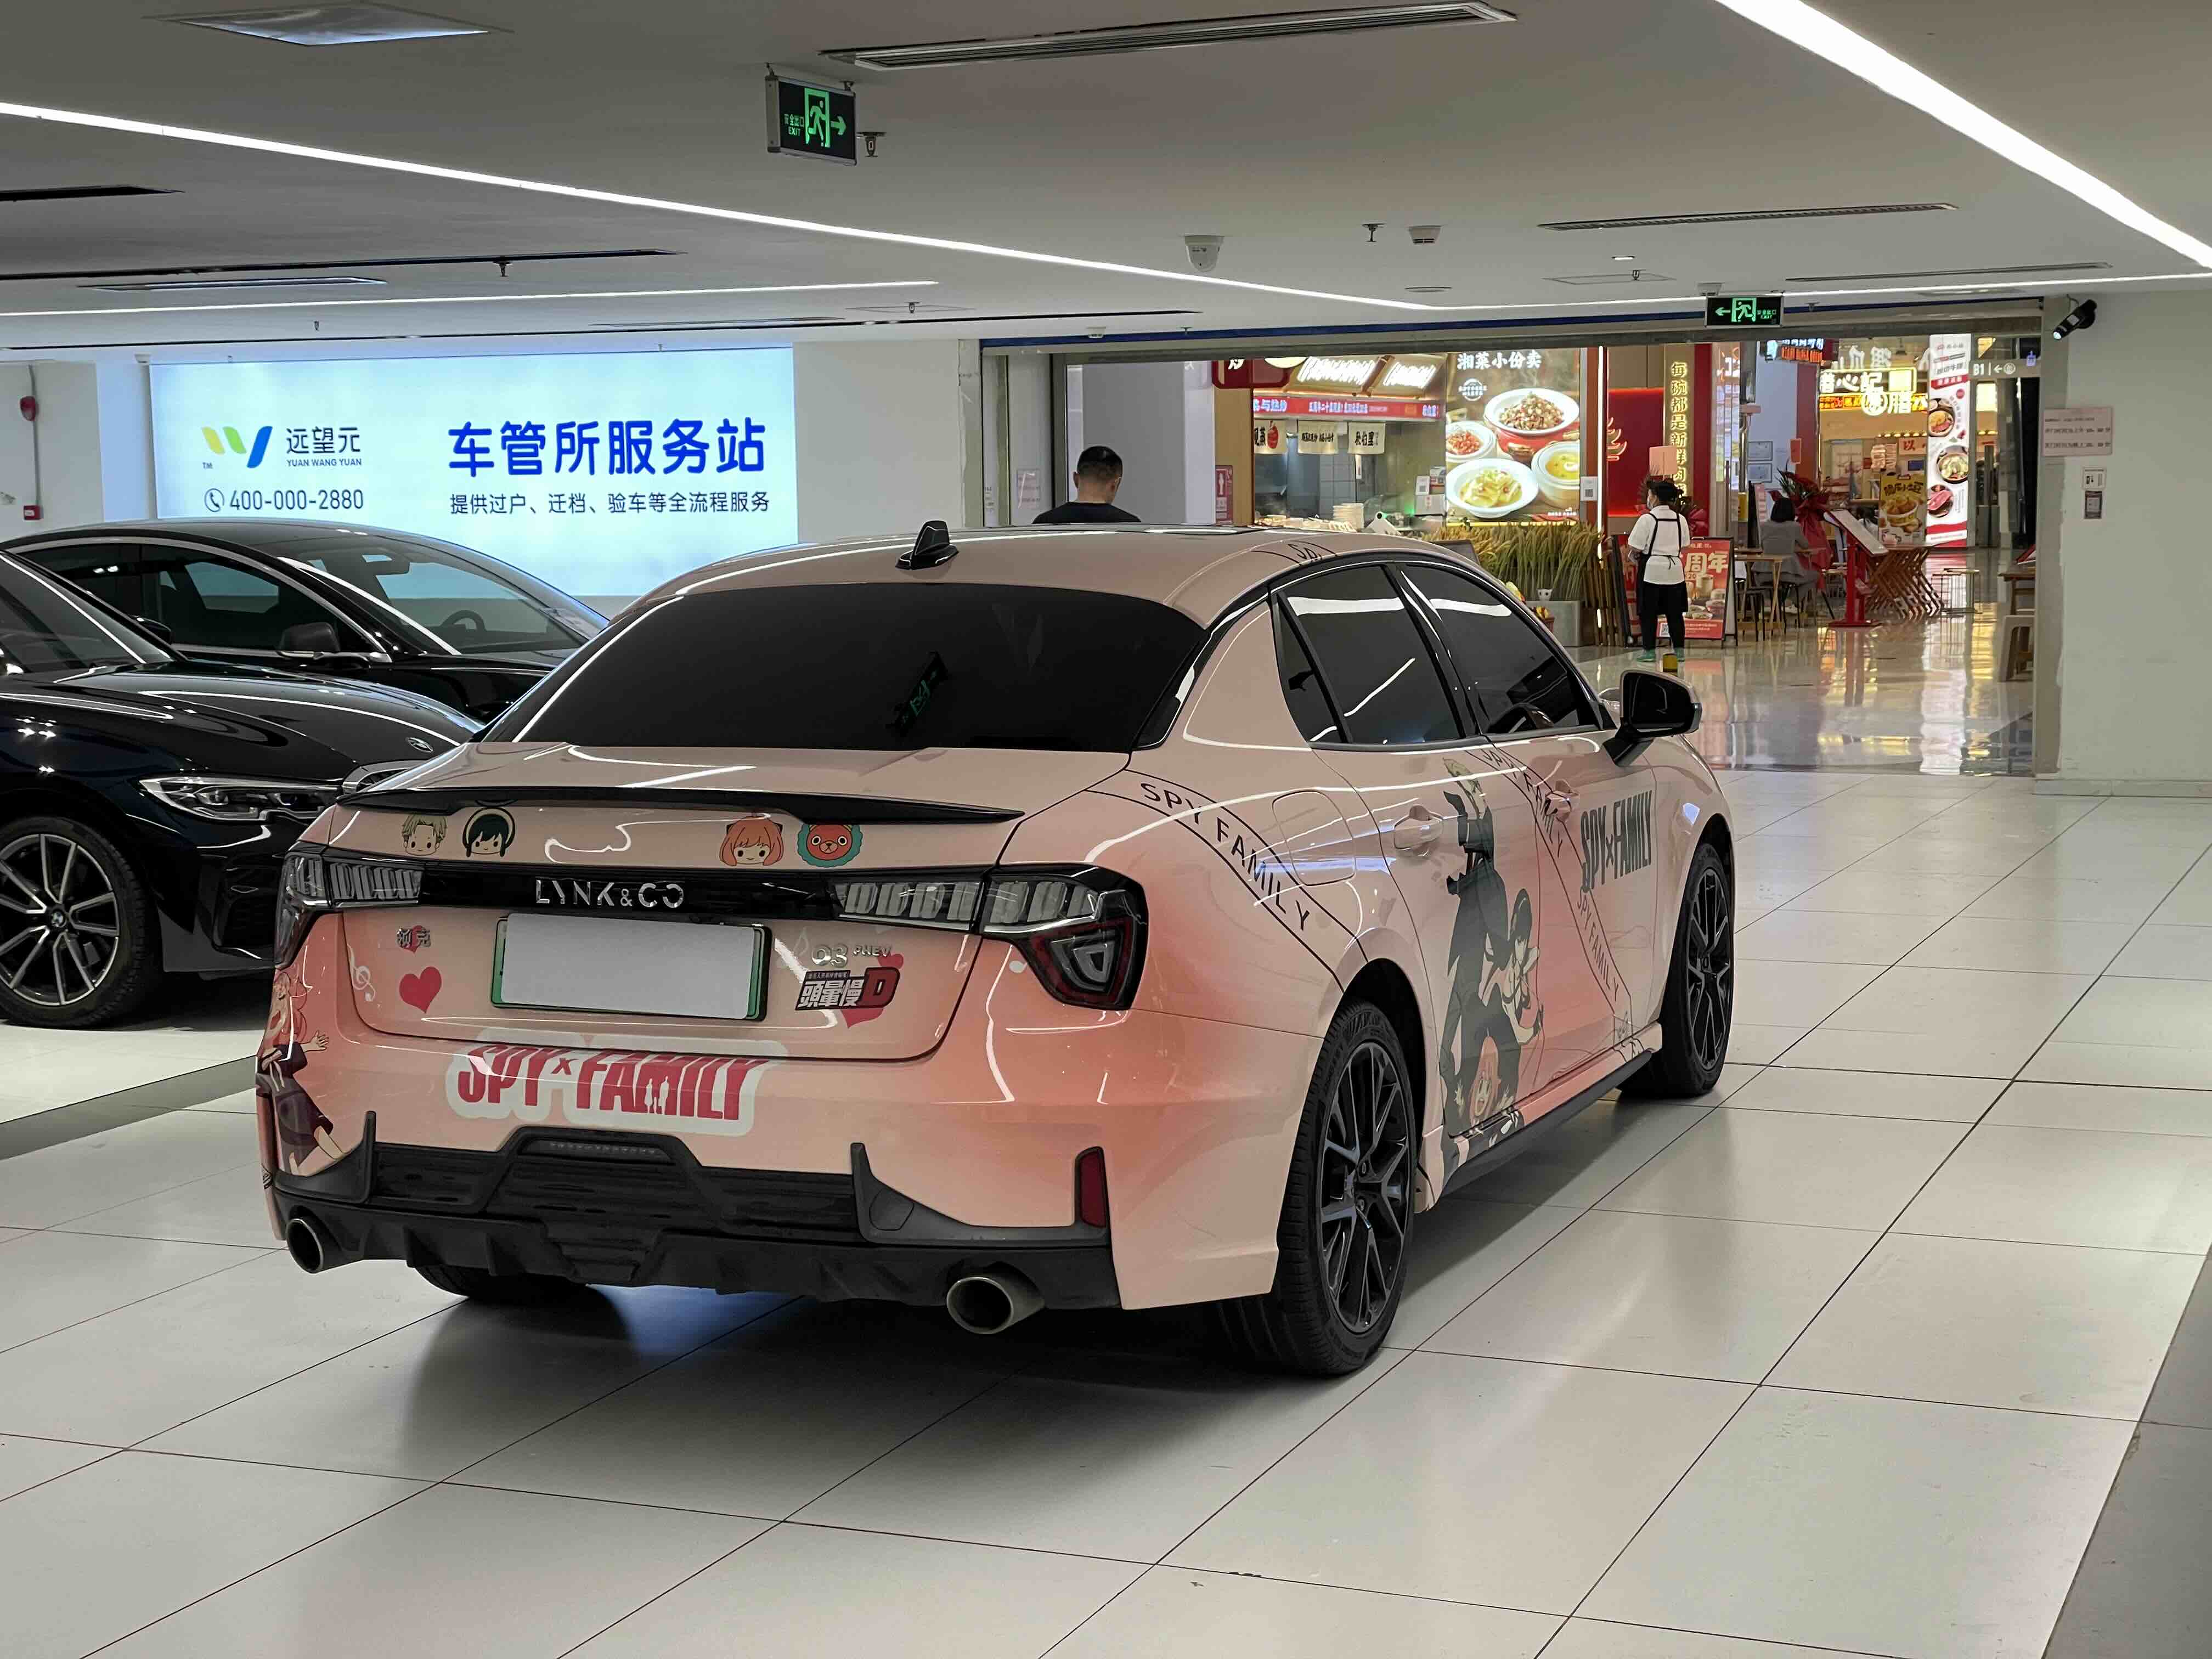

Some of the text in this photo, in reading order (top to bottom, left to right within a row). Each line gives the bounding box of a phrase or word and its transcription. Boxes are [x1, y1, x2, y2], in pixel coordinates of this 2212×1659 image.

[788, 127, 801, 136] EXIT
[286, 426, 360, 453] 远望元
[448, 417, 765, 477] 车管所服务站
[230, 489, 363, 510] 400-000-2880
[1679, 550, 1728, 573] 周年
[1141, 783, 1310, 931] SPY FAMILY
[396, 927, 431, 948] 领克
[853, 943, 891, 957] PHEV
